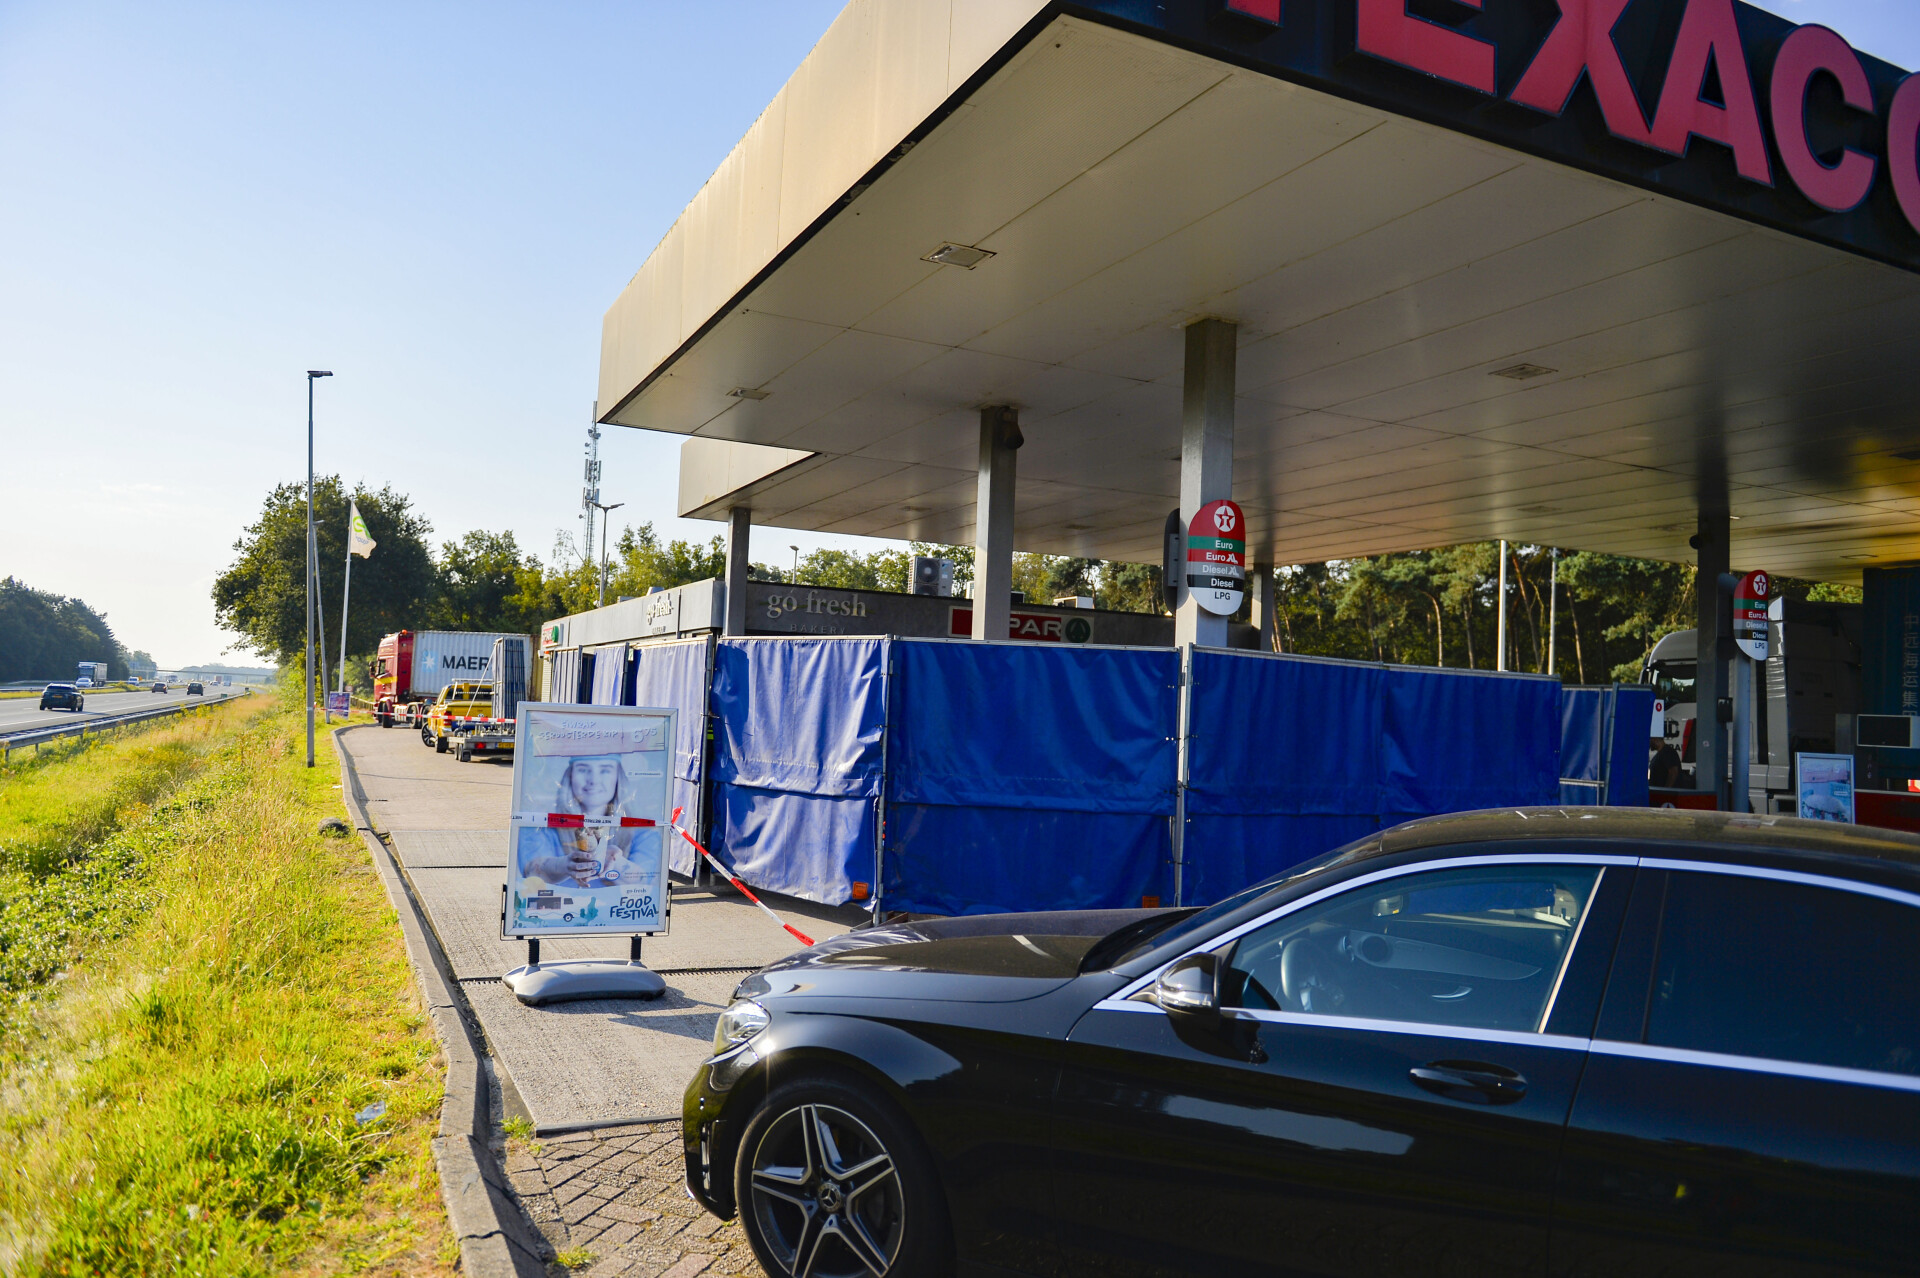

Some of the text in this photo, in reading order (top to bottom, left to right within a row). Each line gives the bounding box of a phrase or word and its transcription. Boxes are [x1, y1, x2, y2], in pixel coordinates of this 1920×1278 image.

[1215, 539, 1233, 549] Euro
[1206, 552, 1226, 562] Euro
[1202, 565, 1228, 575] Diesel
[1210, 578, 1234, 588] Diesel
[1214, 591, 1231, 600] LPG
[767, 589, 868, 619] go fresh
[1754, 601, 1766, 609] Euro
[1748, 611, 1762, 619] Euro
[789, 622, 846, 635] BAKERY
[1009, 616, 1062, 637] PAR
[1745, 621, 1763, 629] Diesel
[1752, 631, 1766, 640] Diesel
[442, 655, 490, 671] MAER
[619, 895, 653, 909] FOOD
[609, 903, 660, 921] FESTIVAL
